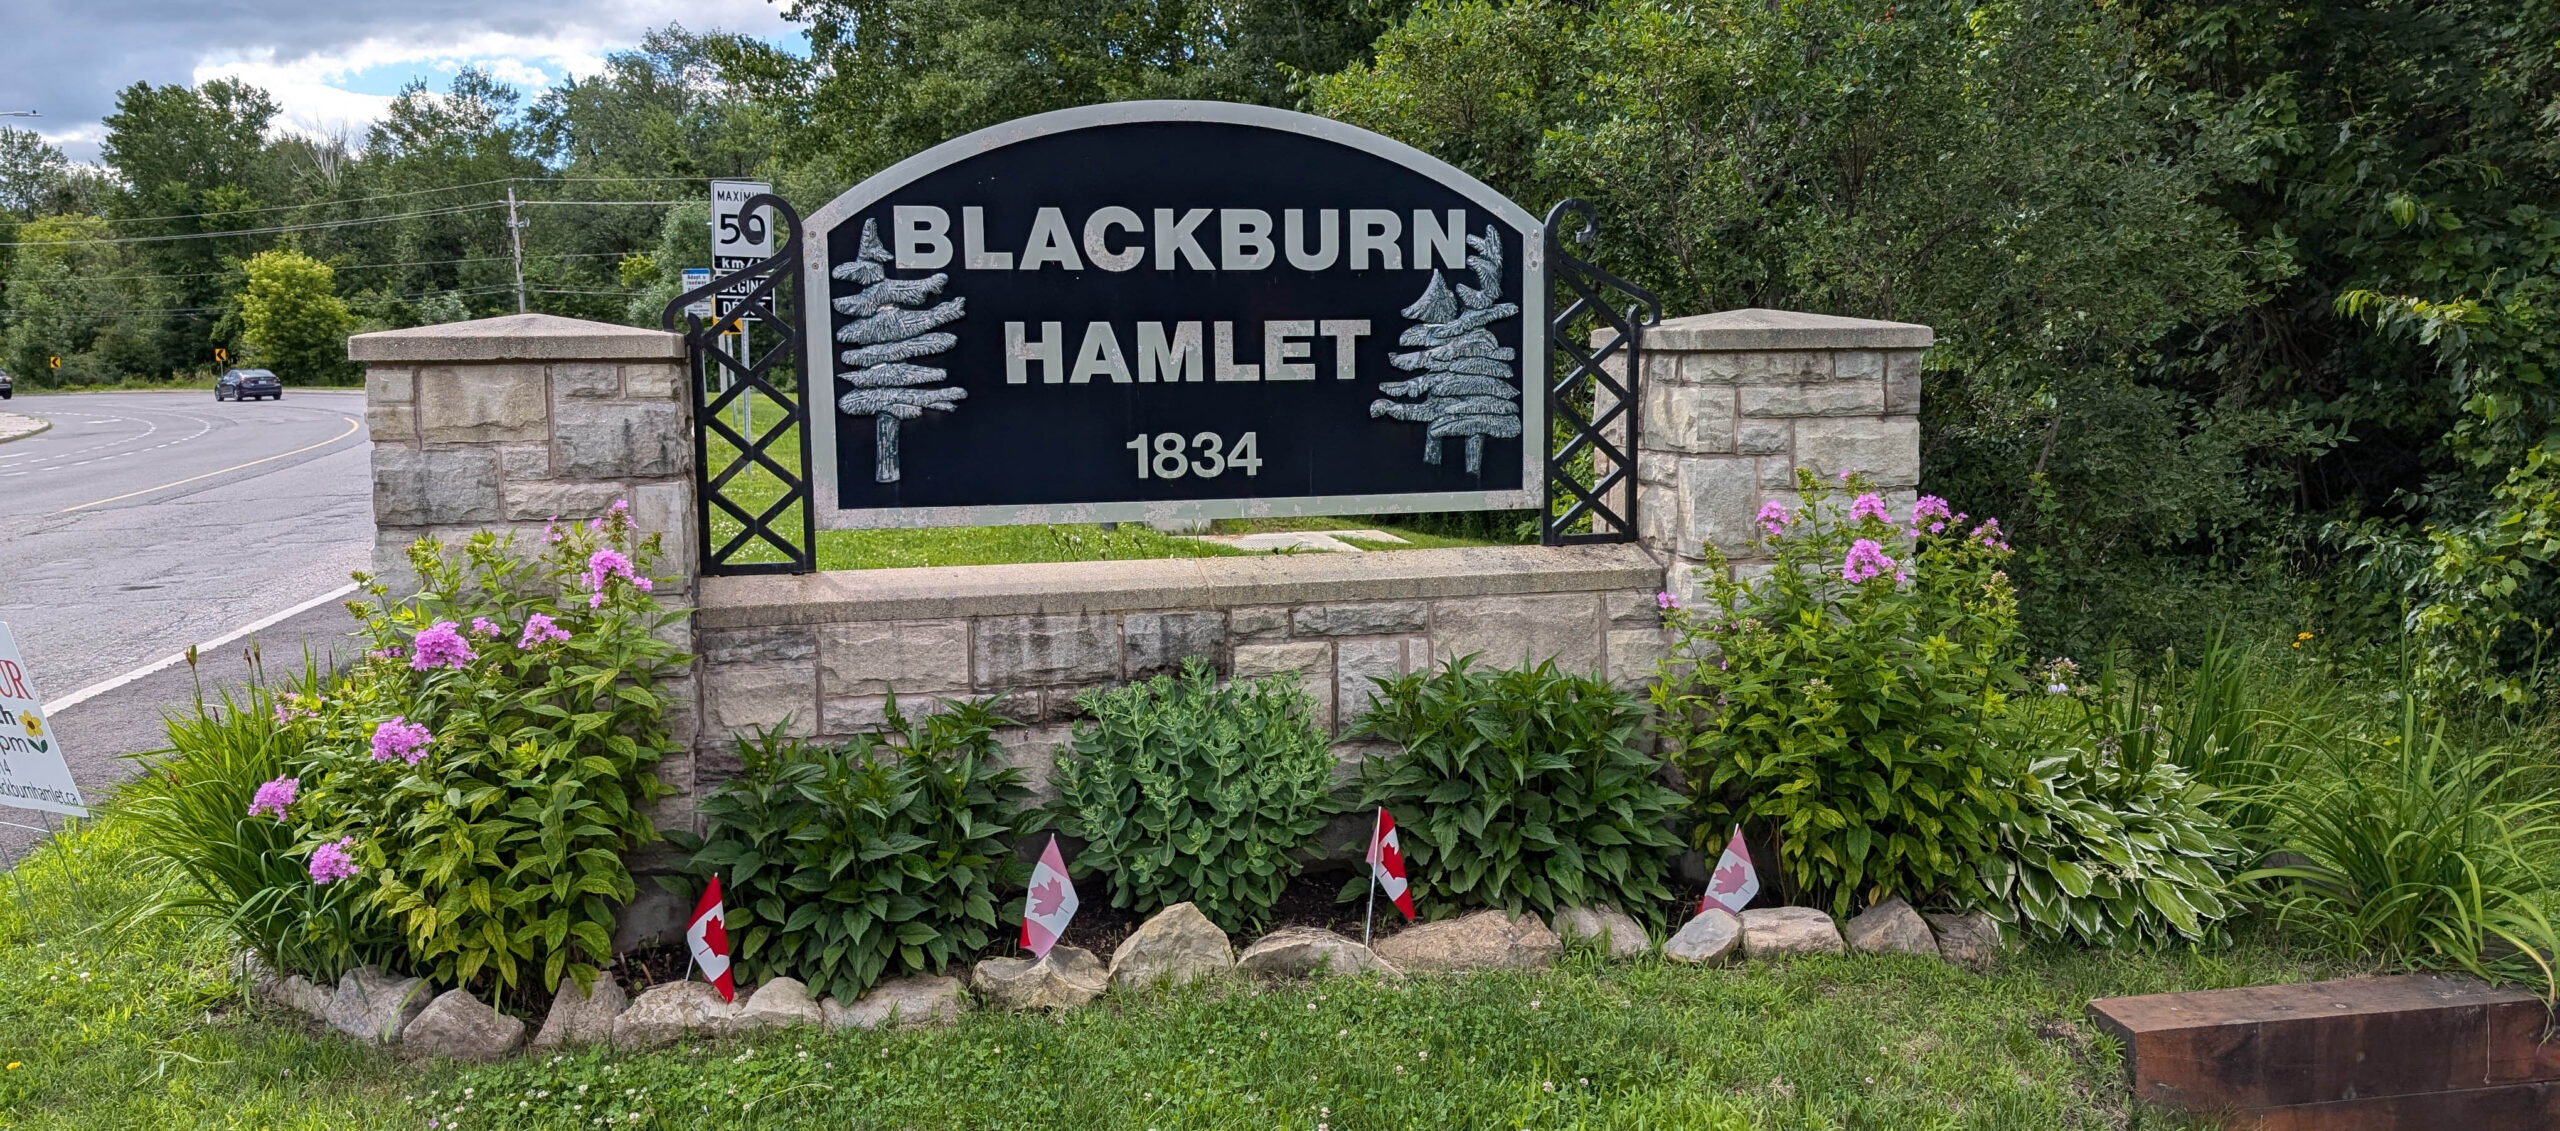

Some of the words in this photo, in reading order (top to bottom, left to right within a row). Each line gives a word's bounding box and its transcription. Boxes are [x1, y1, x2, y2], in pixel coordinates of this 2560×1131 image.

[717, 189, 762, 202] MAXIM
[720, 213, 766, 246] 50
[893, 205, 1467, 273] BLACKBURN
[721, 257, 761, 270] km/
[720, 279, 765, 294] EGIN
[1004, 319, 1371, 384] HAMLET
[1127, 431, 1263, 480] 1834
